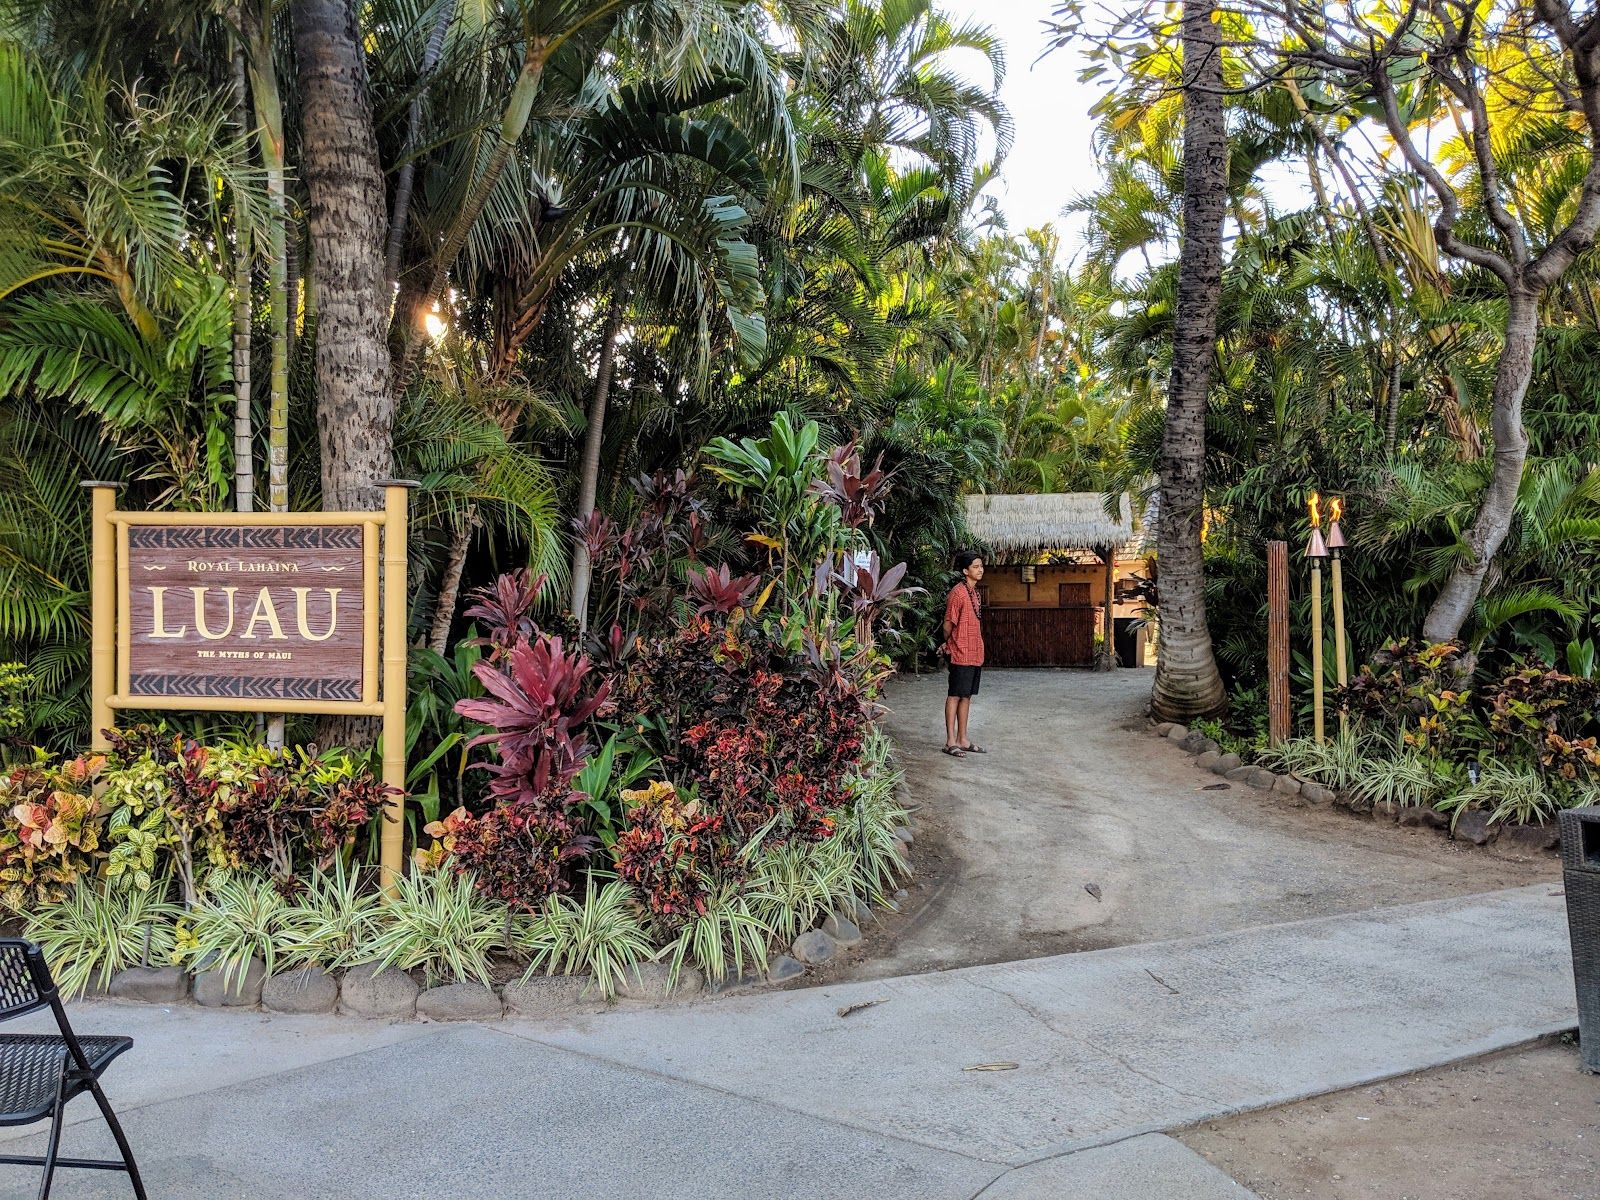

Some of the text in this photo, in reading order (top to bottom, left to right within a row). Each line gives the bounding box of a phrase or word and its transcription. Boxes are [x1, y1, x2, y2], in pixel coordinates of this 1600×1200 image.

[187, 560, 299, 572] ROYAL LAHAINA
[147, 586, 342, 641] LUAU
[197, 650, 292, 660] THE MYTHS OF MAUI
